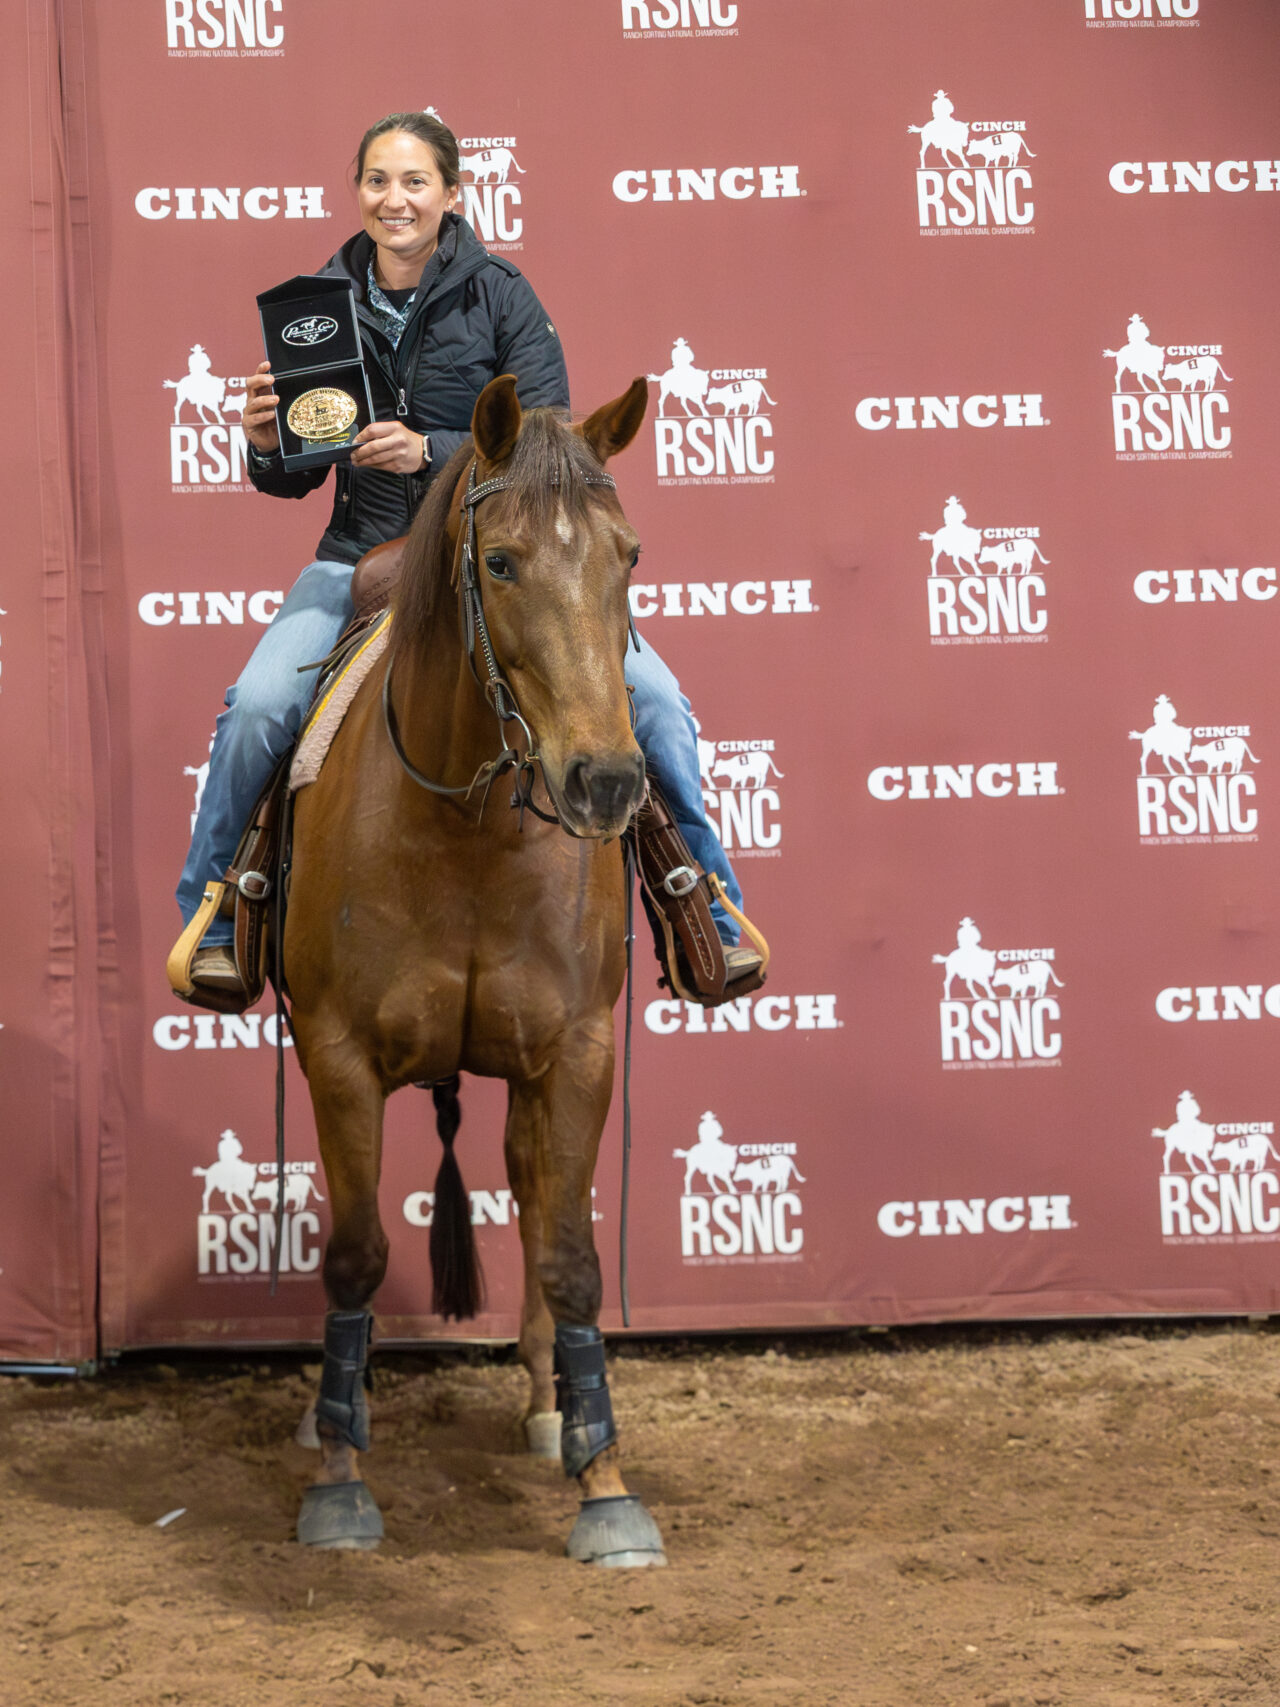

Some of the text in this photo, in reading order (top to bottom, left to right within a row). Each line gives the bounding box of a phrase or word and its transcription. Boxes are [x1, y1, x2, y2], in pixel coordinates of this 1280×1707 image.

[165, 0, 285, 48] RSNC
[461, 137, 517, 148] CINCH
[971, 120, 1026, 132] CINCH
[612, 165, 800, 202] CINCH
[1109, 160, 1280, 194] CINCH
[135, 186, 324, 220] CINCH
[916, 167, 1035, 227] RSNC
[1167, 344, 1222, 356] CINCH
[711, 368, 768, 380] CINCH
[855, 394, 1044, 431] CINCH
[1112, 392, 1232, 452] RSNC
[170, 426, 247, 484] RSN
[654, 416, 774, 476] RSNC
[984, 527, 1040, 539] CINCH
[630, 579, 813, 618] CINCH
[1134, 567, 1280, 604] CINC
[138, 590, 273, 628] CINC
[927, 575, 1048, 635] RSNC
[717, 739, 775, 752] CINCH
[1194, 725, 1250, 737] CINCH
[867, 762, 1058, 801] CINCH
[1136, 776, 1258, 835] RSNC
[997, 948, 1055, 961] CINCH
[152, 1013, 294, 1050] CINC
[644, 994, 837, 1035] CINCH
[940, 999, 1062, 1060] RSNC
[1216, 1122, 1274, 1135] CINCH
[258, 1161, 316, 1173] CICH
[739, 1142, 797, 1155] CINCH
[877, 1195, 1071, 1238] CINCH
[1159, 1174, 1280, 1237] RSNC
[198, 1212, 320, 1274] RSNC
[680, 1193, 804, 1256] RSNC
